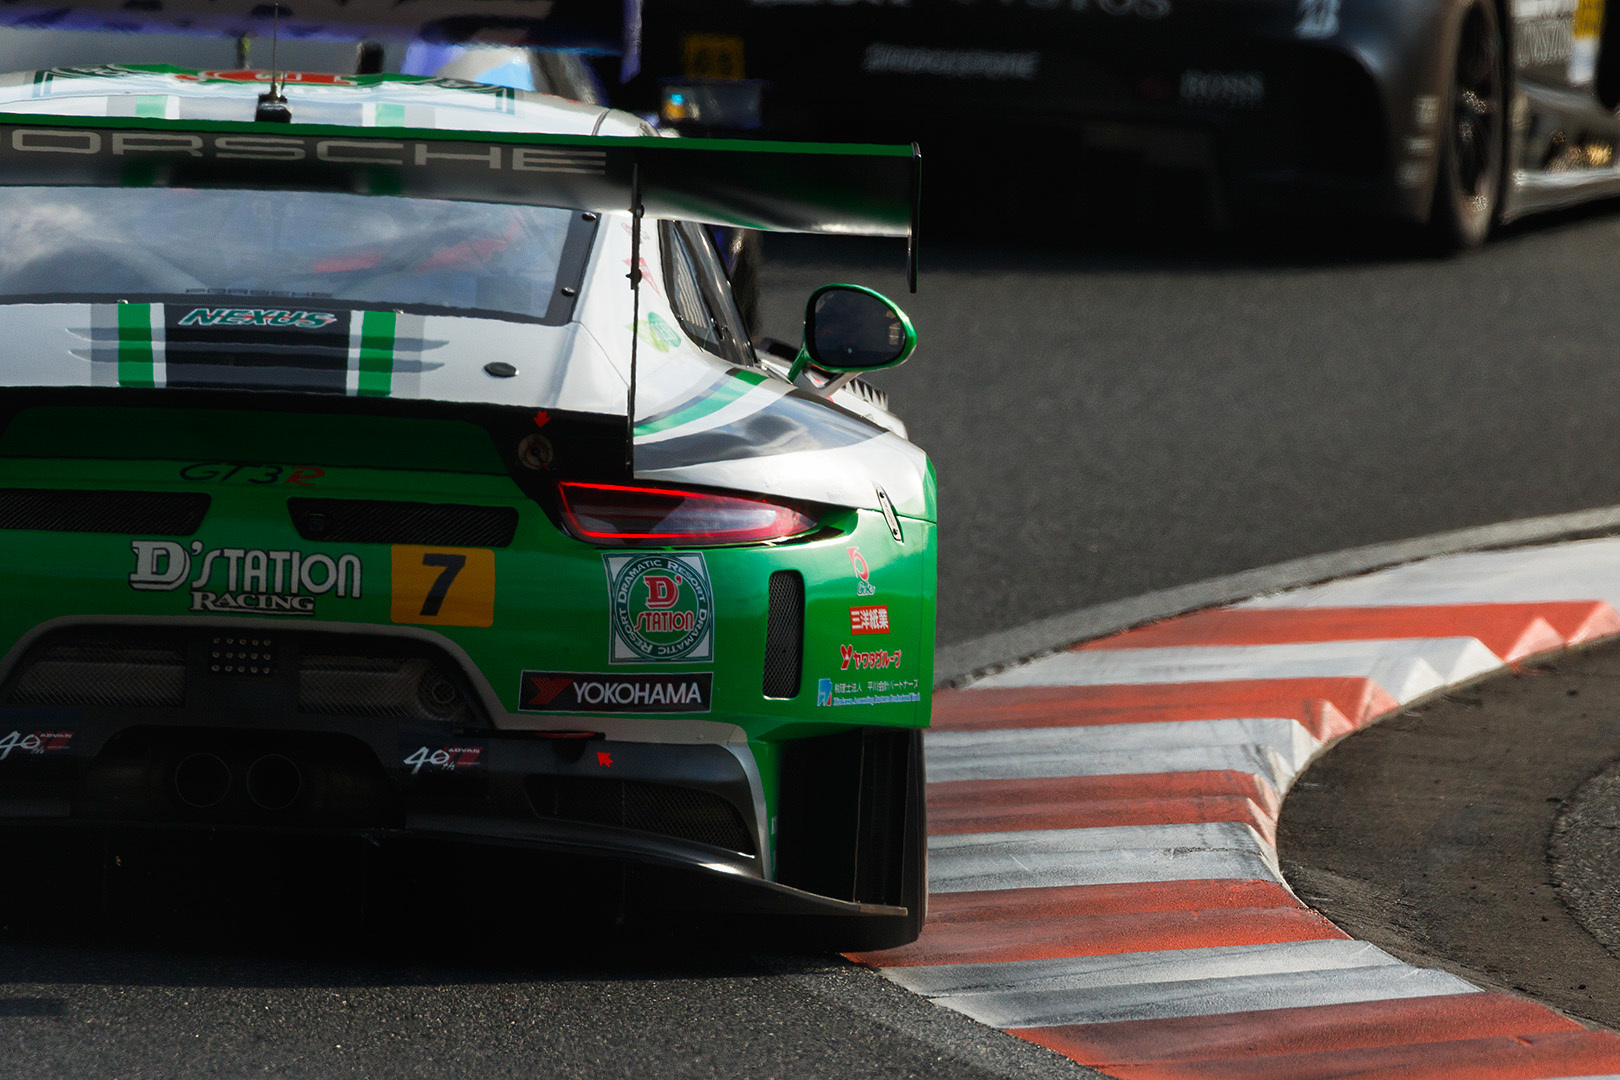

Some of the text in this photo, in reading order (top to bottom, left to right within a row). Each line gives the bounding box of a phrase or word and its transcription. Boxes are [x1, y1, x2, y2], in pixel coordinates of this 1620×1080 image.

[0, 129, 606, 175] ORSCHE
[178, 308, 337, 329] NEXUS
[419, 553, 467, 616] 7
[190, 591, 315, 615] RACING
[572, 682, 703, 705] YOKOHAMA
